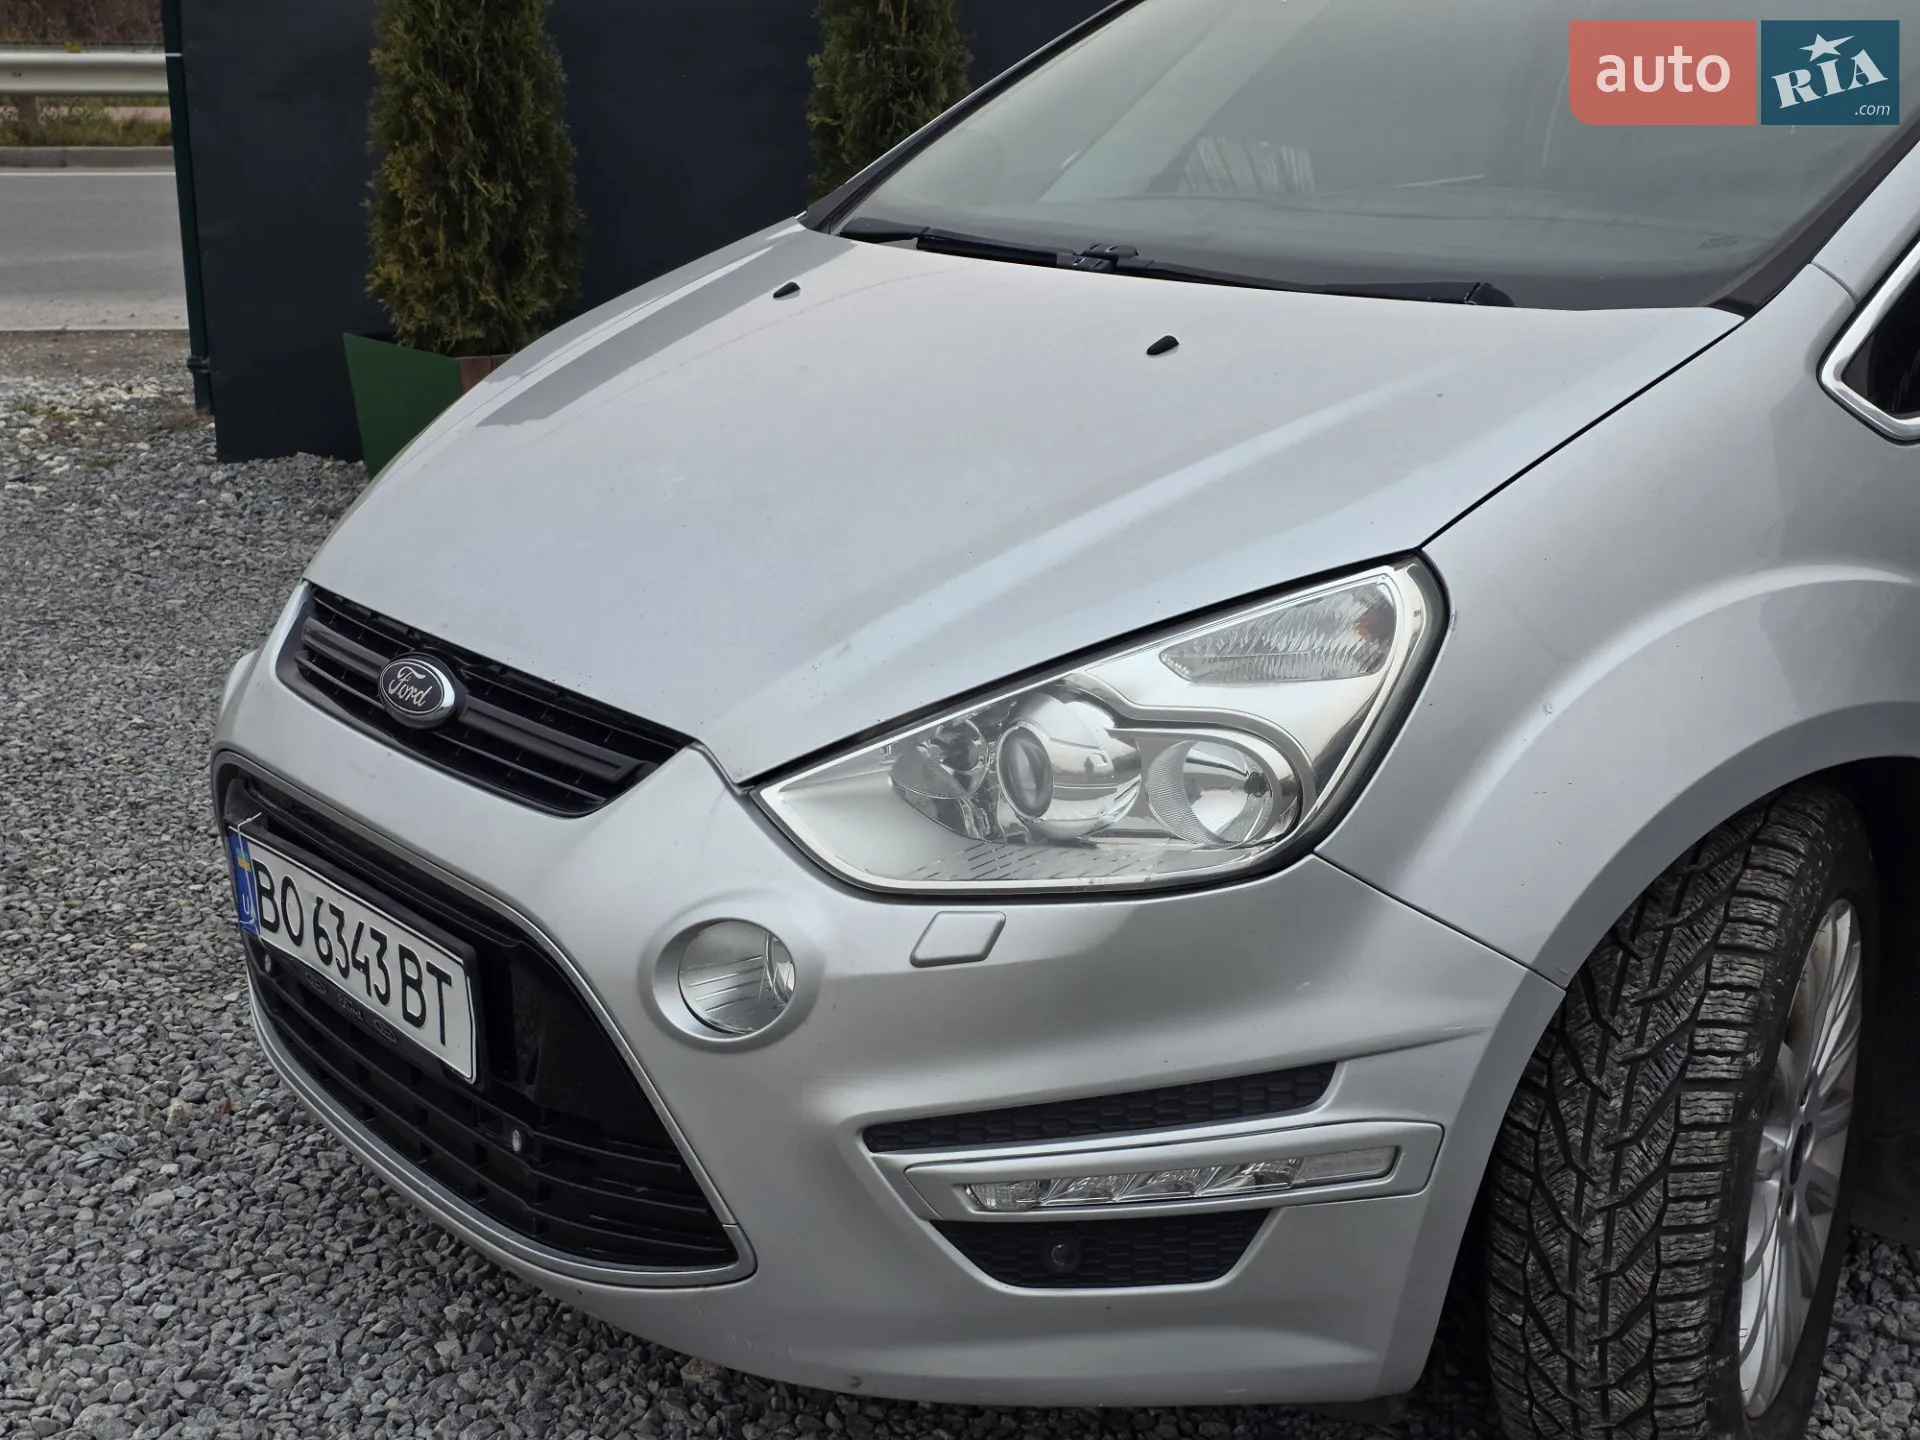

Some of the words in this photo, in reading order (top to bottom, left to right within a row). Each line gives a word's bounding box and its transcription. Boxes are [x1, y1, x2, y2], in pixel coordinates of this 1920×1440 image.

[388, 666, 433, 707] Ford
[252, 858, 304, 947] BO
[313, 896, 391, 1006] 6343
[399, 943, 452, 1046] BT
